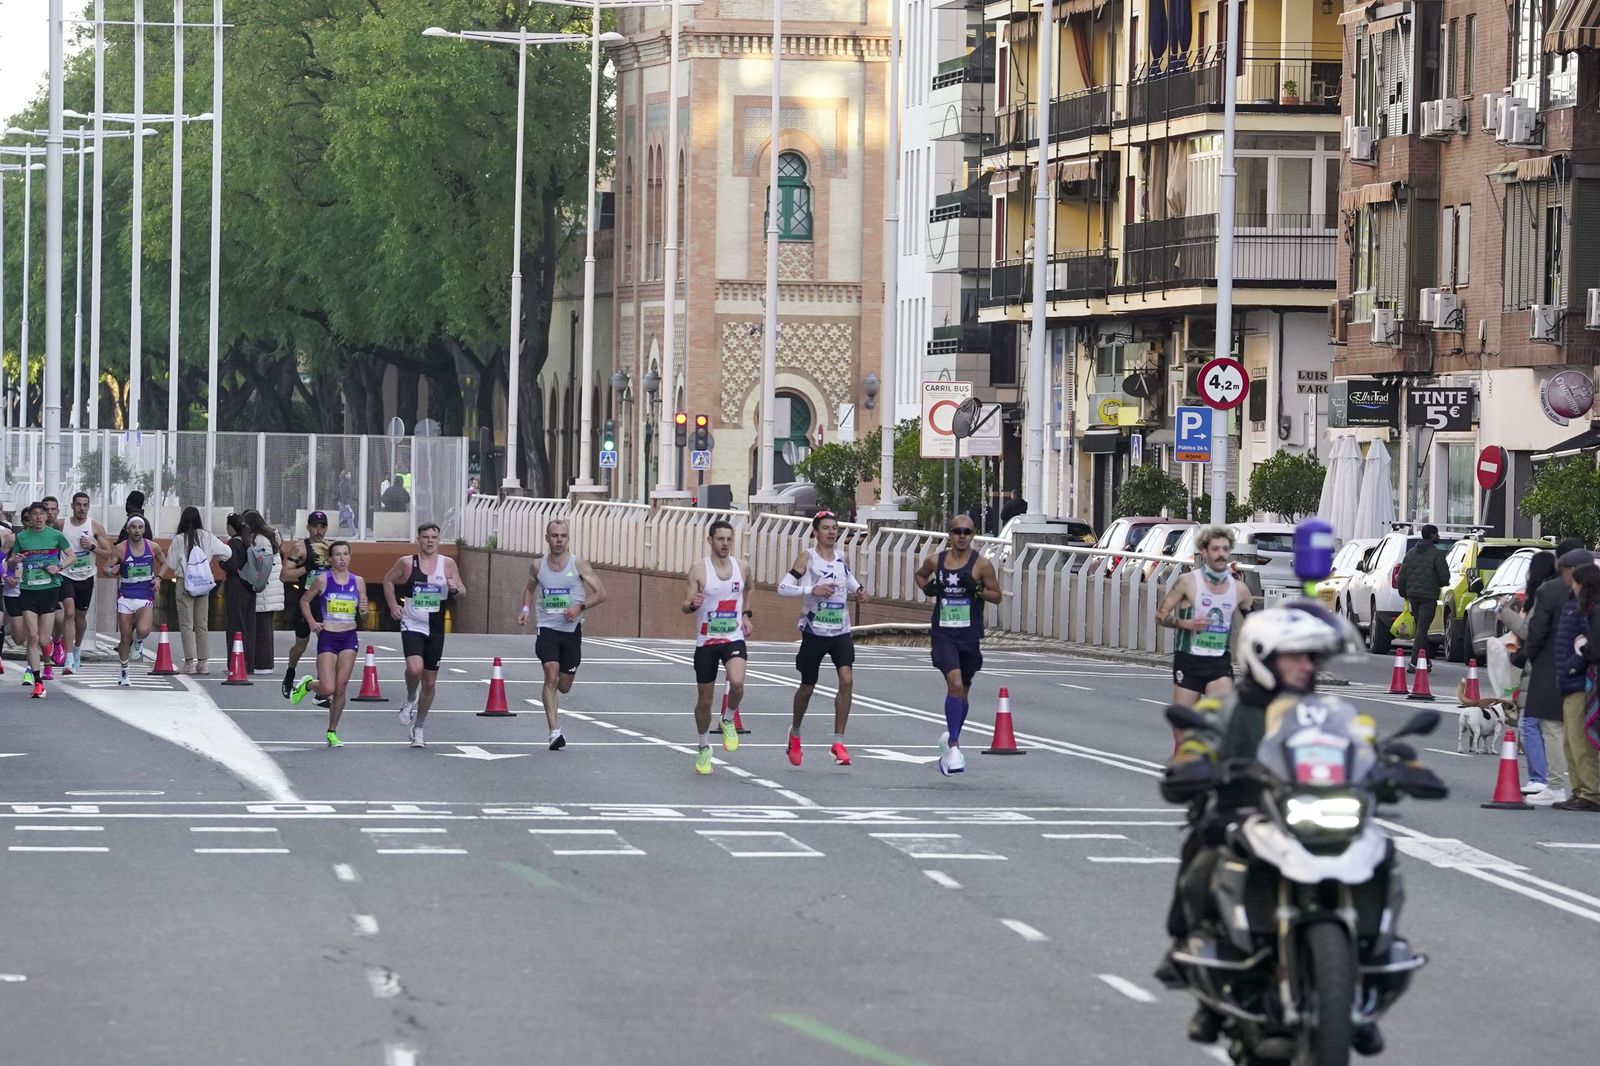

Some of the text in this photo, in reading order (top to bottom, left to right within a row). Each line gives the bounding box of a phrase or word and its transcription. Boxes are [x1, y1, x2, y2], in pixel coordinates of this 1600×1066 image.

[1297, 370, 1328, 380] LUIS
[925, 384, 953, 392] CARRIL
[1411, 391, 1468, 405] TINTE
[1555, 377, 1581, 415] Cruzcampo
[1181, 411, 1203, 440] P
[1425, 405, 1461, 430] 5€
[1296, 702, 1328, 726] tv
